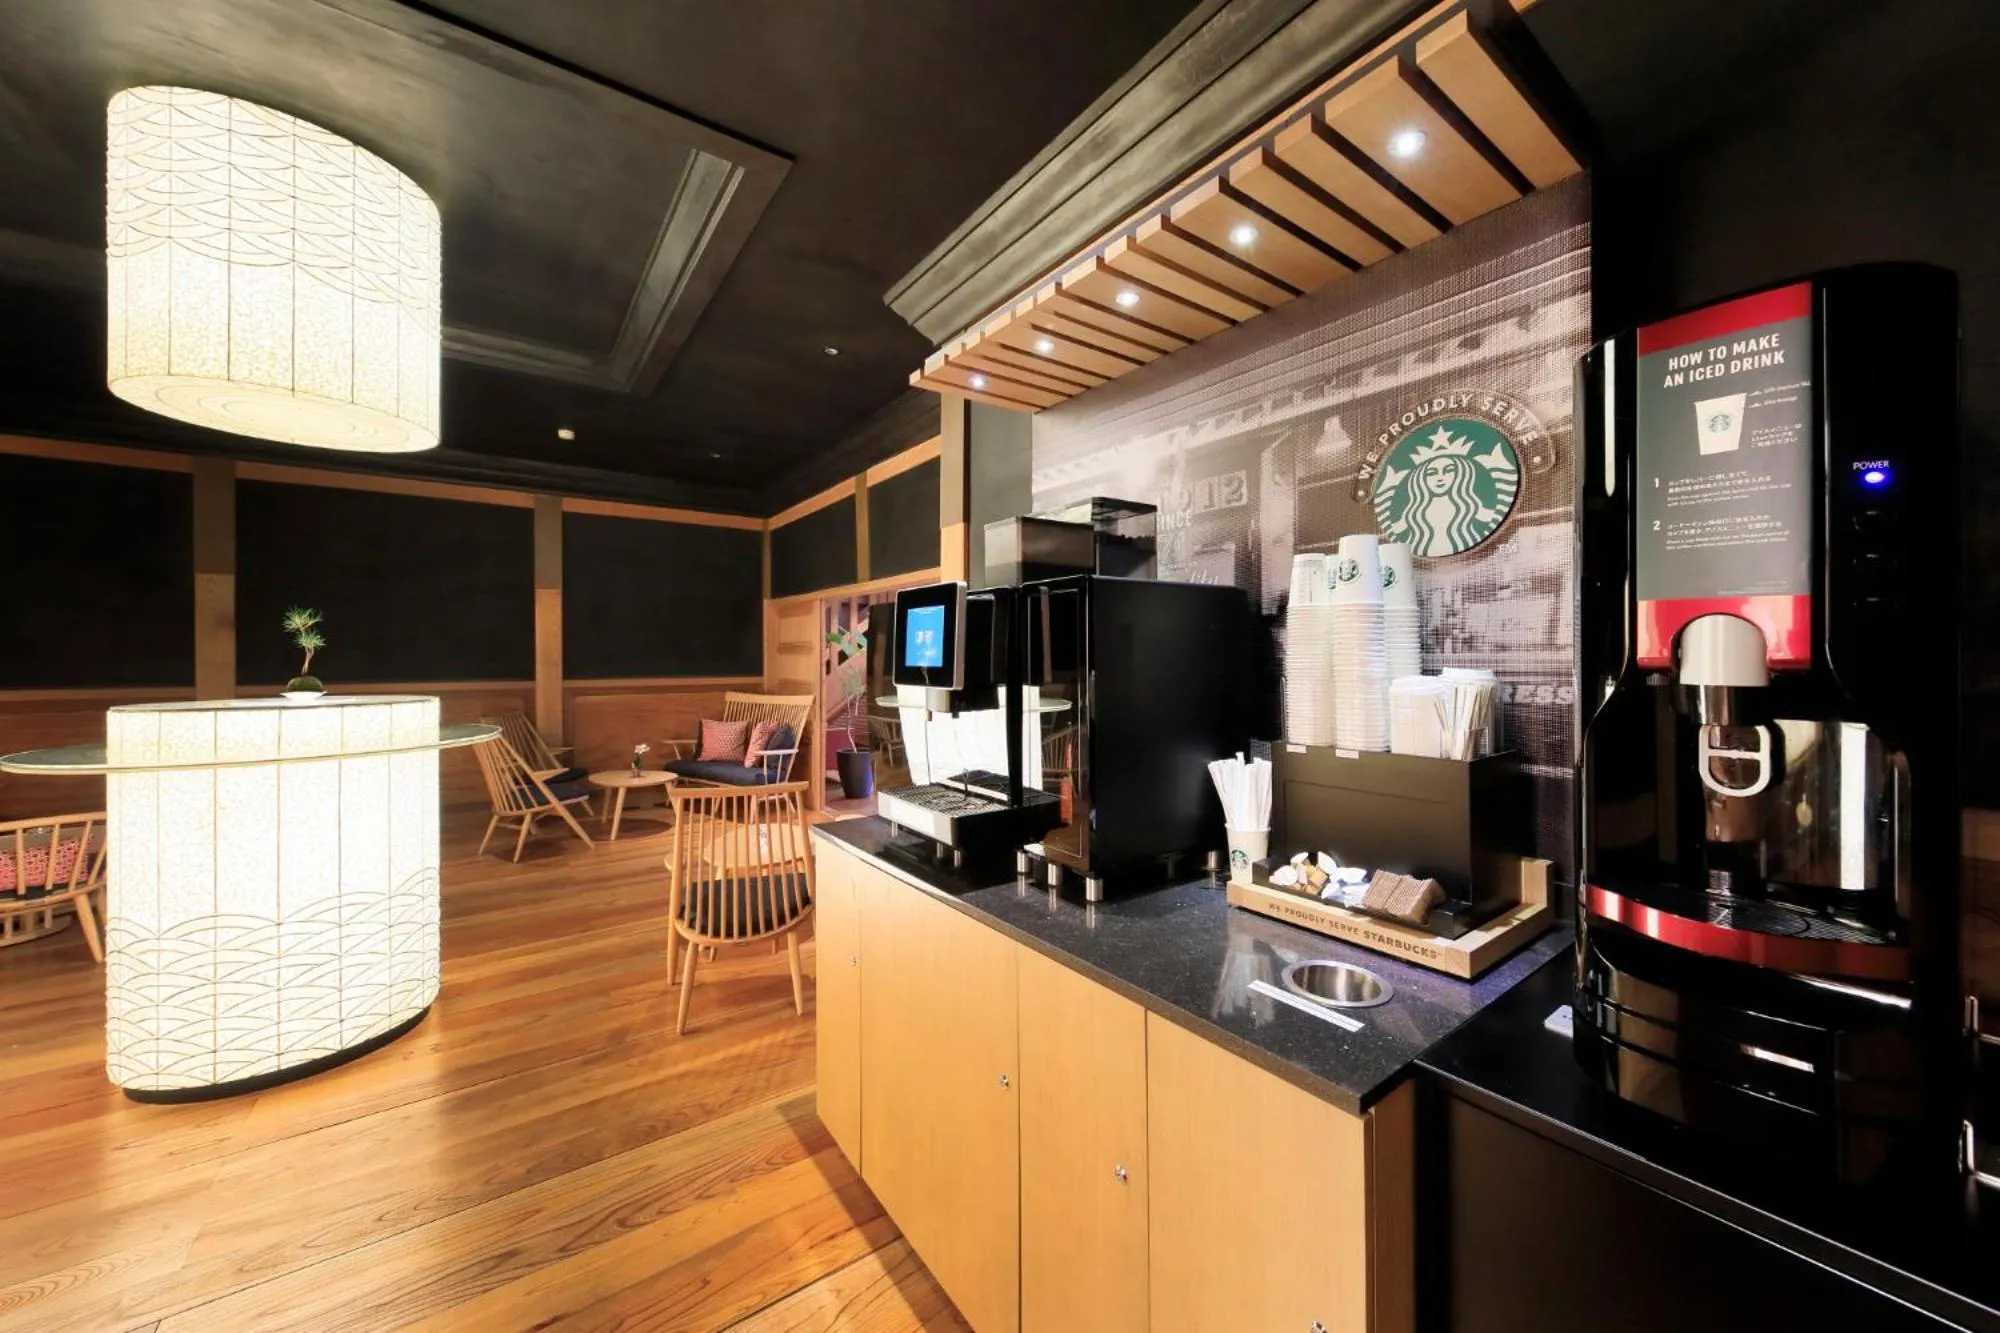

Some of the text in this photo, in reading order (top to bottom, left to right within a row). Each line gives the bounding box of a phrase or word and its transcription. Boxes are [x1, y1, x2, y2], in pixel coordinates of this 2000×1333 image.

[1664, 350, 1785, 388] AN ICED DRINK
[1669, 333, 1780, 371] HOW TO MAKE
[1358, 393, 1539, 480] WE PROUDLY SERVE
[1654, 477, 1660, 488] 1
[1852, 460, 1890, 471] POWER
[1653, 520, 1661, 531] 2
[1268, 903, 1438, 960] WE PROUDLY SERVE STARBUCKS
